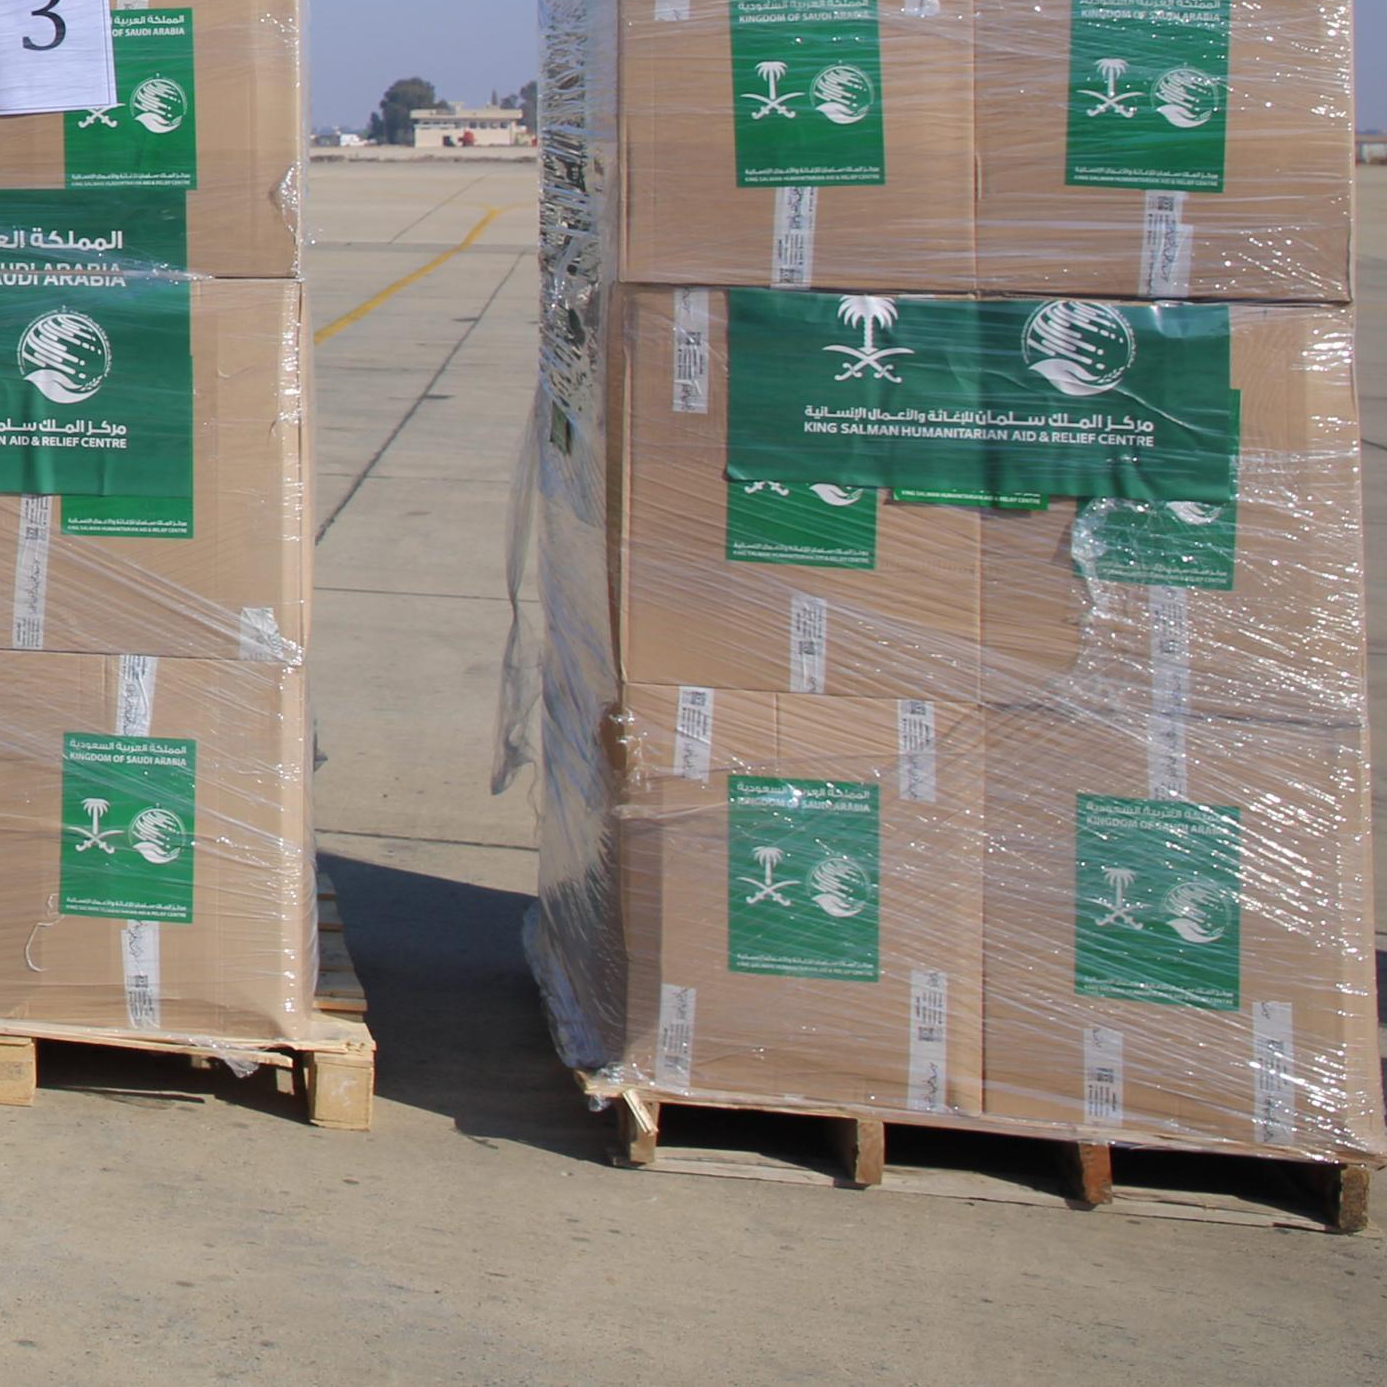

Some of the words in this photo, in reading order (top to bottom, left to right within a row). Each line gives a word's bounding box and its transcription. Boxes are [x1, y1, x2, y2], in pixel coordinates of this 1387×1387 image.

[739, 14, 786, 23] KINGDOM
[787, 13, 800, 22] OF
[802, 12, 832, 21] SAUDI
[111, 28, 124, 37] OF
[125, 28, 152, 36] SAUDI
[153, 27, 185, 35] ARABIA
[30, 227, 123, 251] المملكة
[42, 263, 127, 287] ARABIA
[39, 418, 85, 433] الملك
[975, 410, 1046, 426] سلمان
[1048, 413, 1103, 429] الملك
[1105, 415, 1155, 432] مركز
[86, 420, 127, 436] مركز
[804, 422, 837, 434] KING
[840, 423, 900, 436] SALMAN
[901, 425, 1007, 441] HUMANITARIAN
[1011, 430, 1036, 442] AID
[1038, 431, 1049, 443] &
[1052, 432, 1096, 444] RELIEF
[1098, 434, 1154, 447] CENTRE
[9, 435, 29, 446] AID
[31, 436, 40, 446] &
[42, 436, 79, 447] RELIEF
[81, 437, 127, 448] CENTRE
[70, 752, 111, 762] KINGDOM
[113, 755, 125, 763] OF
[126, 755, 153, 764] SAUDI
[154, 757, 187, 766] ARABIA
